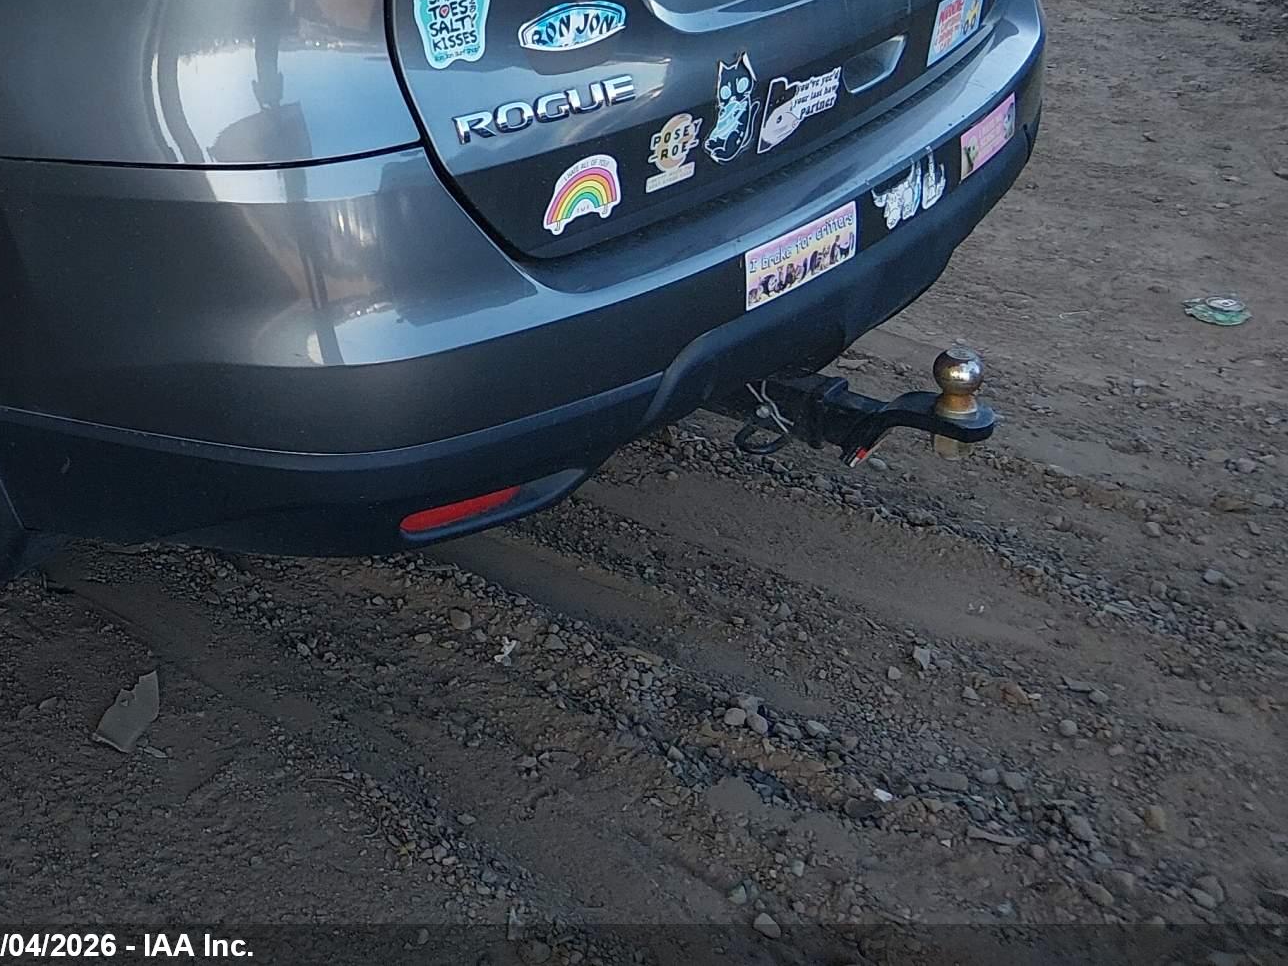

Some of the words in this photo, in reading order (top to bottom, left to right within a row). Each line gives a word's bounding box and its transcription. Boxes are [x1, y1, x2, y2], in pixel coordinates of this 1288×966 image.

[427, 0, 468, 20] TOES
[429, 13, 477, 37] SALTY
[531, 14, 572, 46] RON
[575, 13, 616, 35] JON
[432, 30, 478, 52] KISSES
[452, 74, 636, 145] ROGUE
[800, 96, 835, 120] partner
[653, 123, 701, 148] POSEY
[761, 246, 792, 270] brake
[795, 236, 812, 254] for
[815, 213, 853, 241] critters
